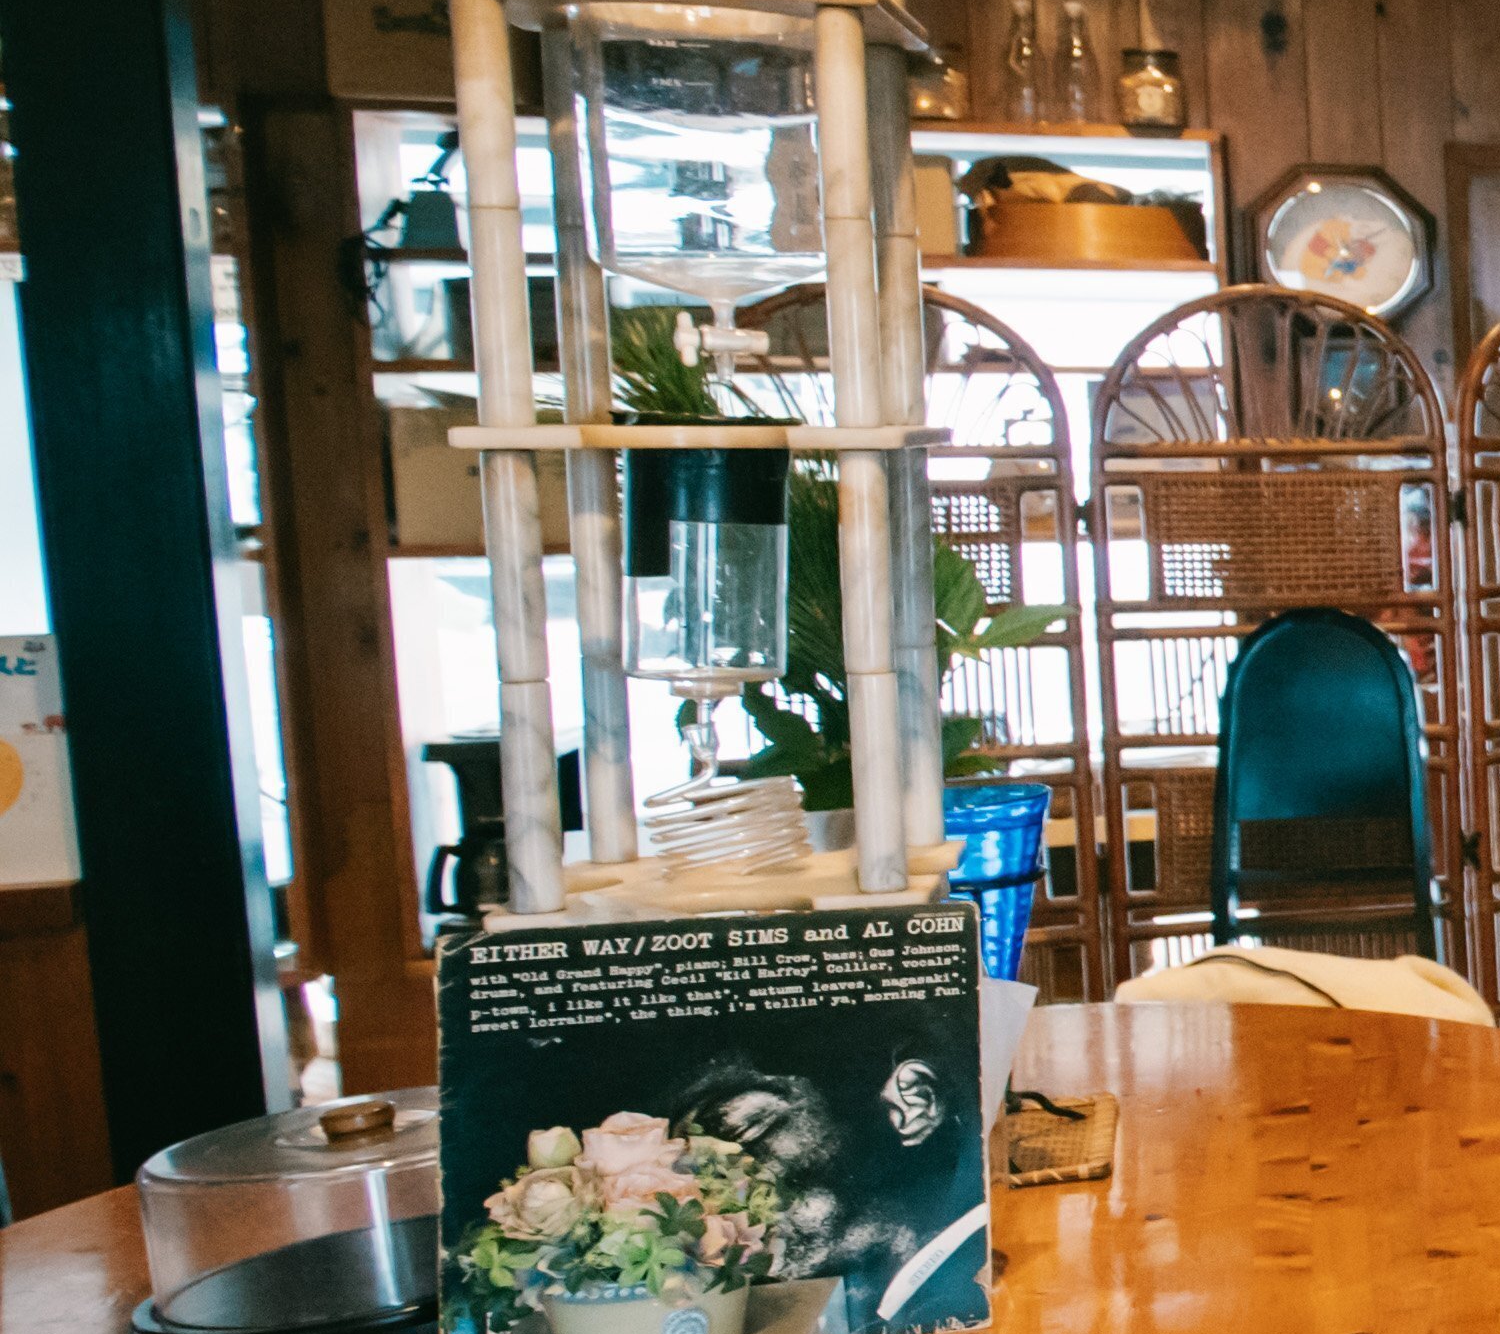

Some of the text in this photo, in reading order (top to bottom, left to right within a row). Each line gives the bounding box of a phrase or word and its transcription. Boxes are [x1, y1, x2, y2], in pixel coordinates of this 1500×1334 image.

[469, 942, 569, 964] EITHER
[727, 927, 789, 947] SIMS
[803, 924, 850, 942] and
[862, 921, 894, 938] AL
[906, 916, 966, 935] COHN
[469, 975, 508, 986] with
[512, 971, 549, 982] "Old
[556, 967, 602, 980] Grand
[732, 956, 768, 967] Bill
[775, 954, 817, 964] Crow,
[822, 950, 863, 961] bass;
[869, 948, 895, 958] Gus
[901, 943, 967, 956] Johnson,
[469, 988, 525, 1000] drums,
[533, 984, 564, 995] and
[571, 978, 654, 993] featuring
[661, 973, 707, 986] Cecil
[715, 970, 751, 981] "Kid
[825, 961, 893, 974] Collier,
[470, 1005, 537, 1020] p-town,
[548, 1002, 556, 1012] i
[566, 999, 604, 1011] like
[612, 996, 631, 1007] it
[640, 993, 677, 1005] like
[749, 984, 803, 997] autumn
[812, 979, 872, 992] leaves,
[471, 1020, 519, 1033] sweet
[630, 1008, 657, 1020] the
[666, 1004, 720, 1018] thing,
[728, 1001, 756, 1012] i'm
[764, 995, 825, 1010] tellin'
[830, 994, 857, 1007] ya,
[863, 988, 926, 1002] morning
[934, 985, 967, 997] fun.
